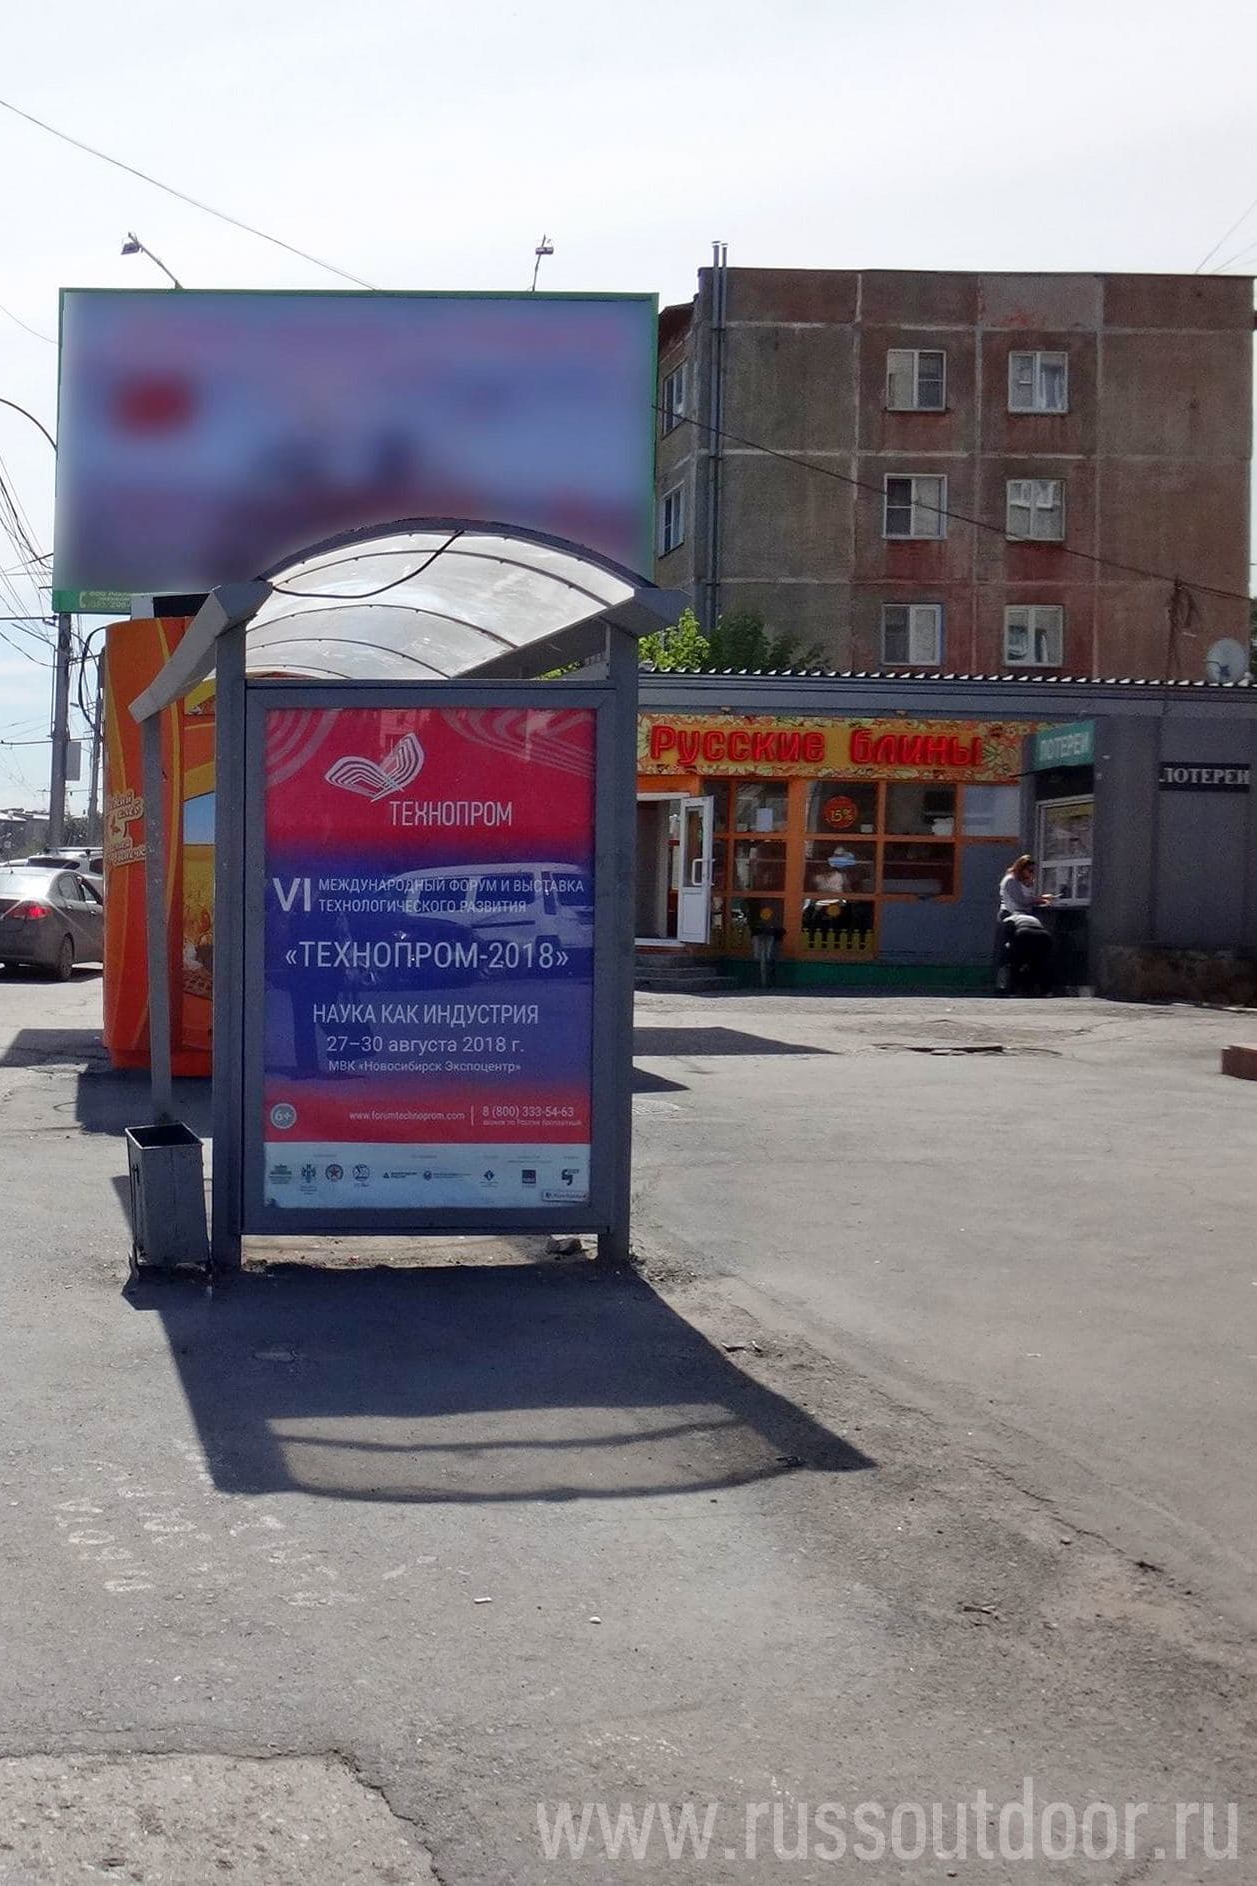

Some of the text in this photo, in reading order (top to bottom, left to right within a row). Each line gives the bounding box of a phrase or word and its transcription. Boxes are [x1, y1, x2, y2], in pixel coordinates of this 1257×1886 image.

[649, 725, 984, 767] Русские блины
[389, 801, 513, 826] ТЕХНОПРОМ
[272, 877, 311, 912] VI
[319, 877, 584, 894] МЕЖДУНАРОДНЫЙ ФОРУМ И ВЫСТАВКА
[319, 899, 527, 914] ТЕХНОЛОГИЧЕСКОГО РАЗВИТИЯ
[285, 941, 569, 969] «ТЕХНОПРОМ-2018»
[313, 1004, 539, 1028] НАУКА КАК ИНДУСТРИЯ
[387, 1038, 457, 1056] августа
[463, 1037, 506, 1052] 2018
[512, 1039, 524, 1052] г.
[329, 1060, 522, 1074] МВК «Новосибирск Экспоцентр»
[273, 1109, 293, 1124] 6+
[482, 1106, 490, 1117] 8
[492, 1105, 520, 1118] (800)
